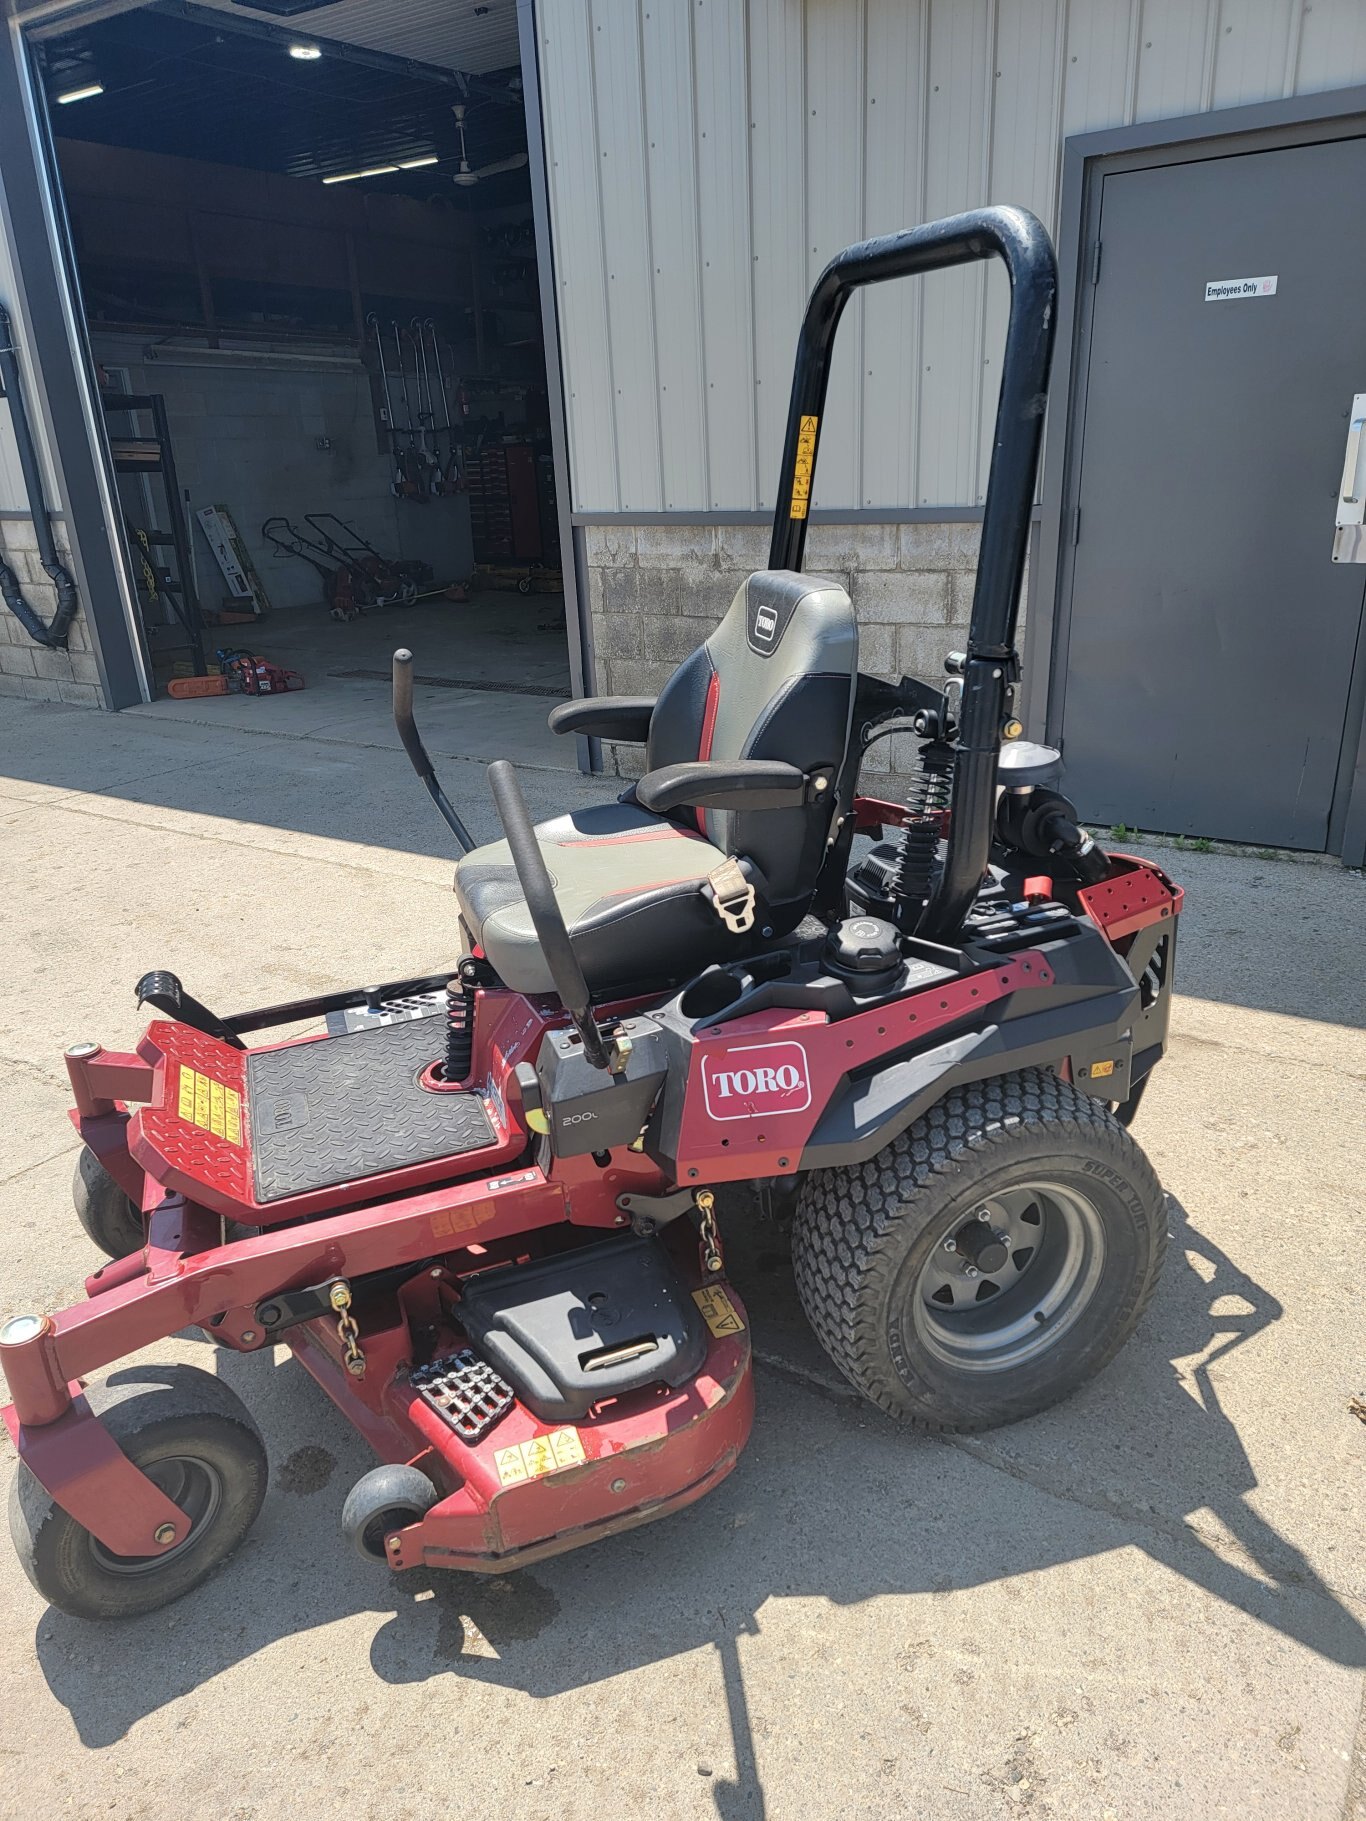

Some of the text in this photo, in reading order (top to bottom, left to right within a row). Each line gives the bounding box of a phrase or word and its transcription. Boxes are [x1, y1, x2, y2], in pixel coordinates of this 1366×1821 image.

[1207, 282, 1258, 298] Employees Only
[712, 1064, 800, 1098] TORO
[1081, 1160, 1150, 1232] SUPER TURF
